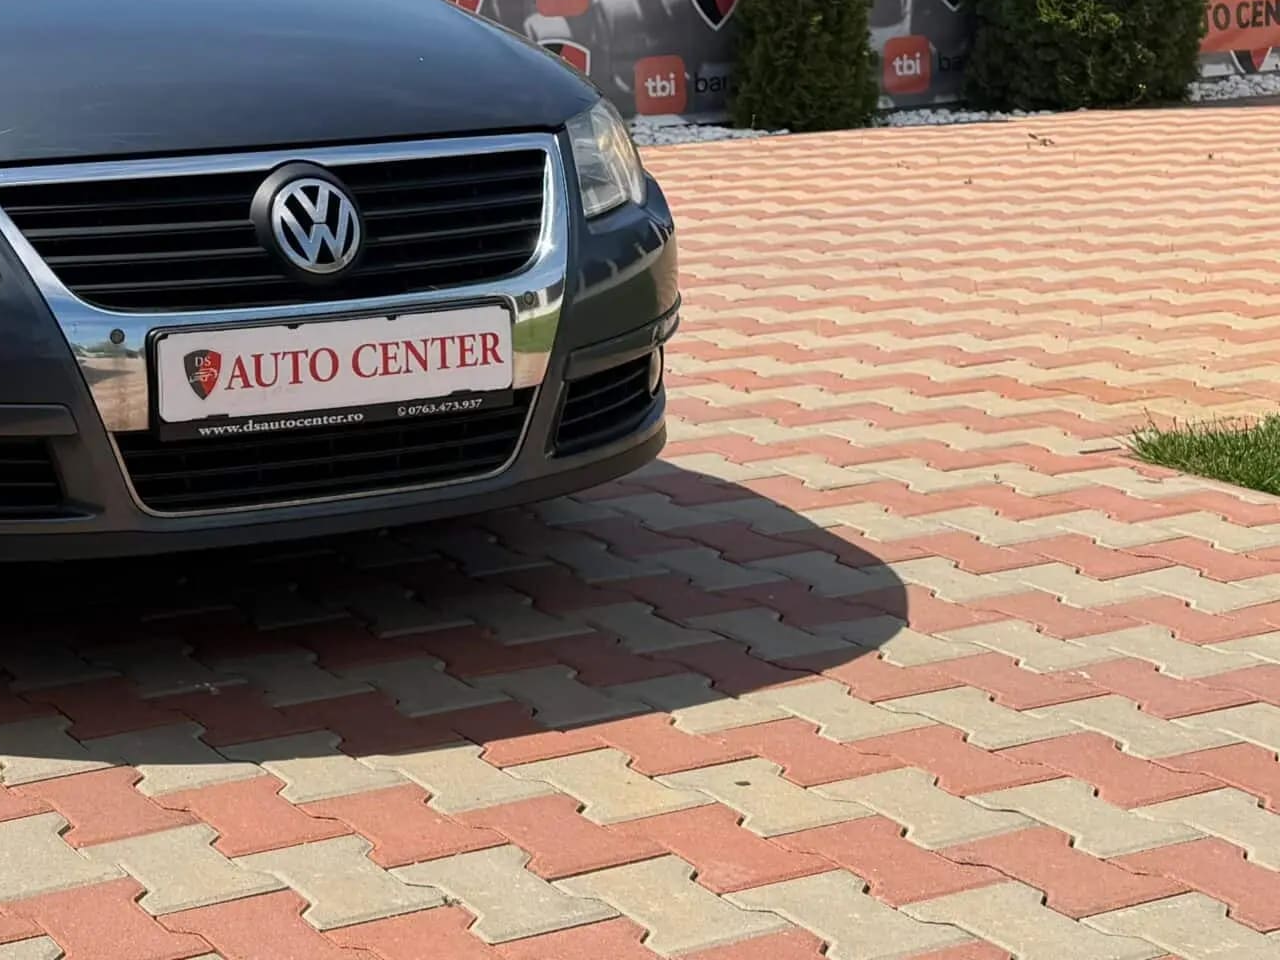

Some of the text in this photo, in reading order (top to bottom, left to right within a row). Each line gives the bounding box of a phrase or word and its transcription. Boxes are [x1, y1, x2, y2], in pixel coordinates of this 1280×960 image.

[892, 52, 921, 76] tbi
[645, 72, 727, 97] tbi ba
[195, 356, 211, 368] DS
[224, 331, 505, 390] AUTO CENTER
[198, 398, 484, 437] www.dsautocenter.ro 0763.473.937
